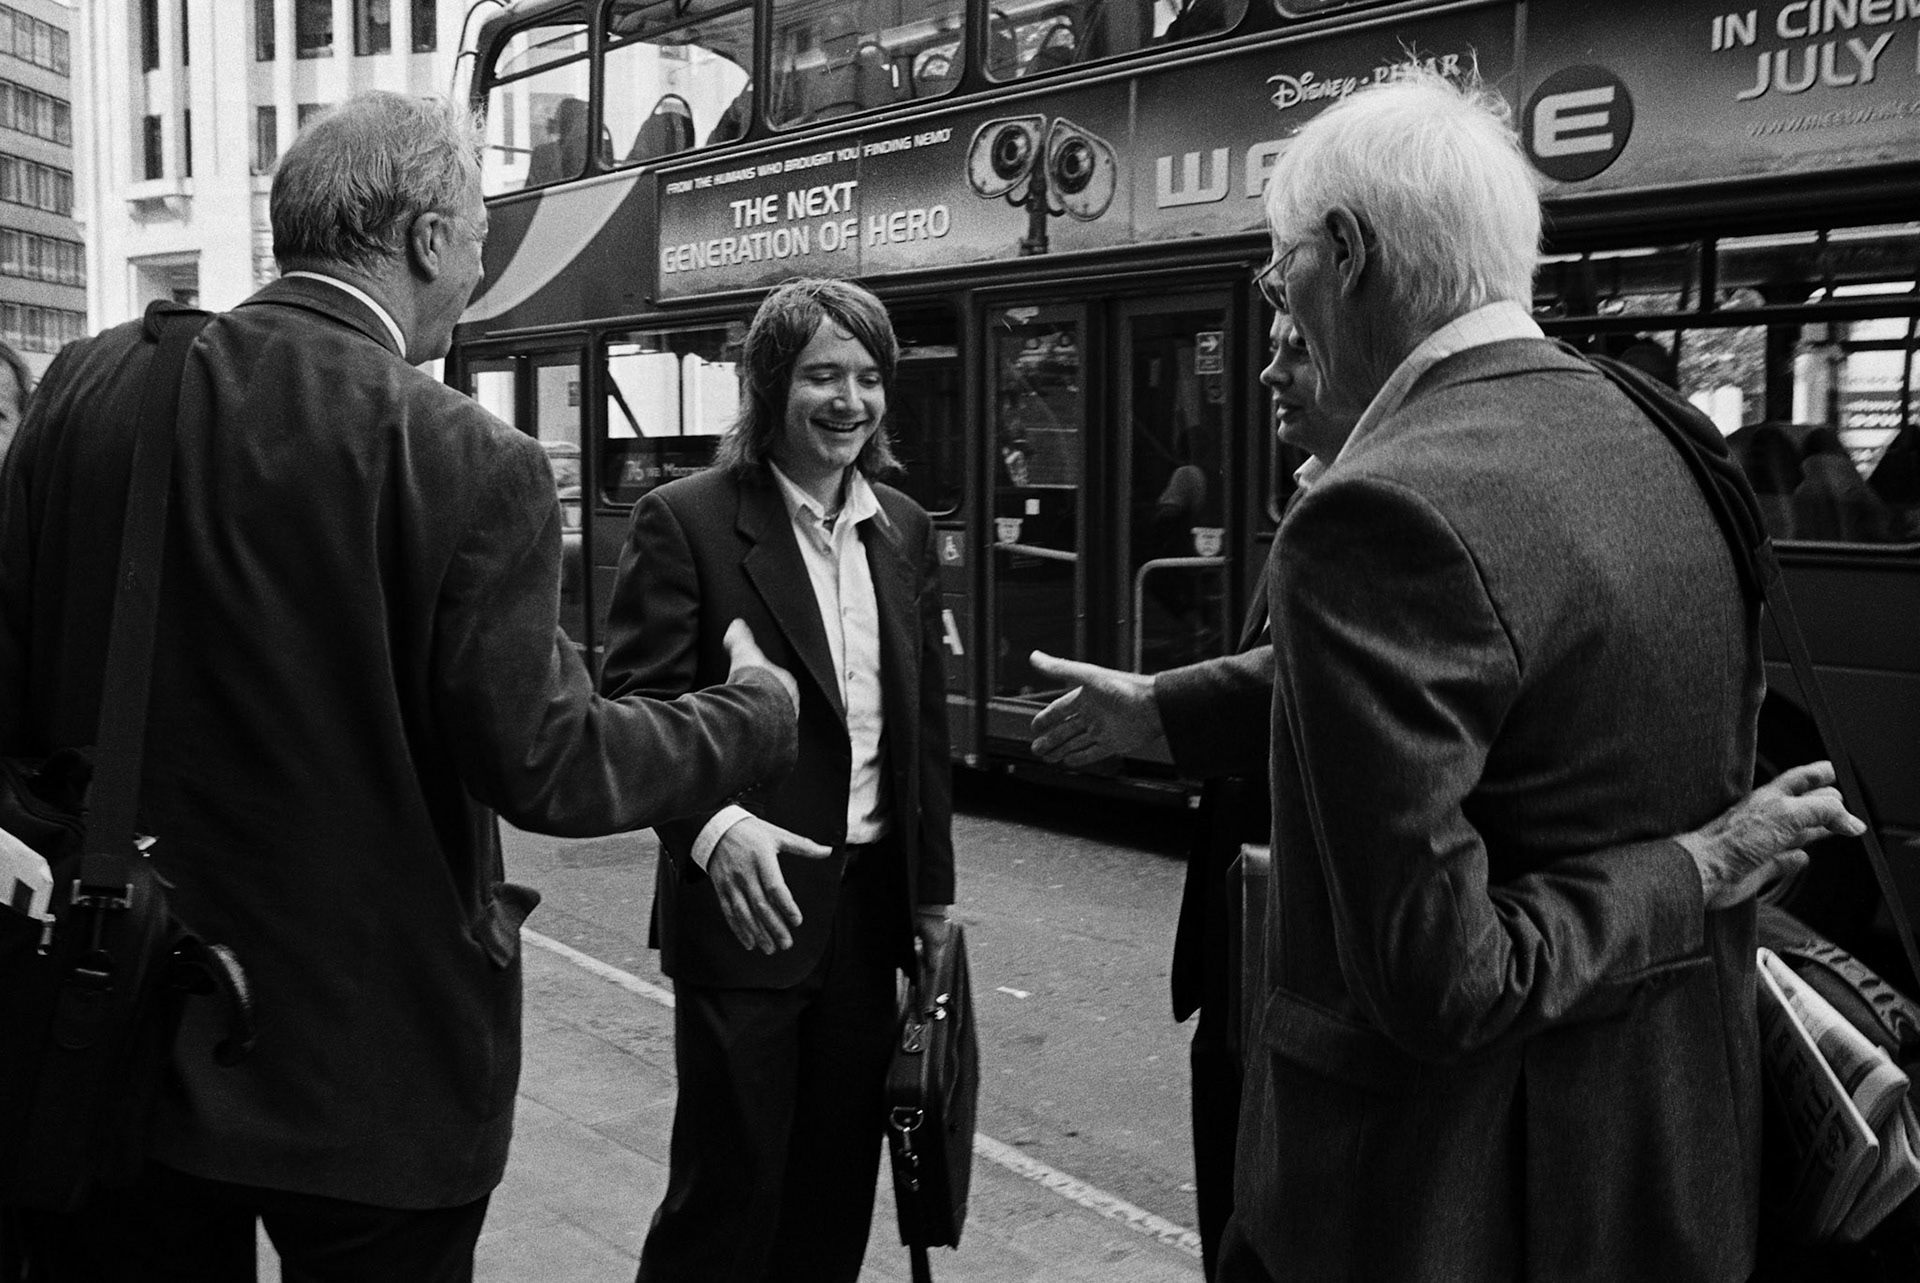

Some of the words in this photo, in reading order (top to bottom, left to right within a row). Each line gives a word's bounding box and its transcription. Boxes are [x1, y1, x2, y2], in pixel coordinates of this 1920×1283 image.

[1711, 10, 1758, 52] IN
[1737, 31, 1895, 101] JULY
[666, 180, 694, 194] FROM
[694, 175, 713, 189] THE
[713, 167, 756, 185] HUMANS
[757, 161, 783, 177] WHO
[783, 151, 836, 172] BROUGHT
[836, 147, 860, 162] YOU
[730, 194, 779, 229] THE
[787, 180, 859, 220] NEXT
[661, 224, 810, 274] GENERATION
[819, 218, 859, 253] OF
[868, 204, 951, 247] HERO
